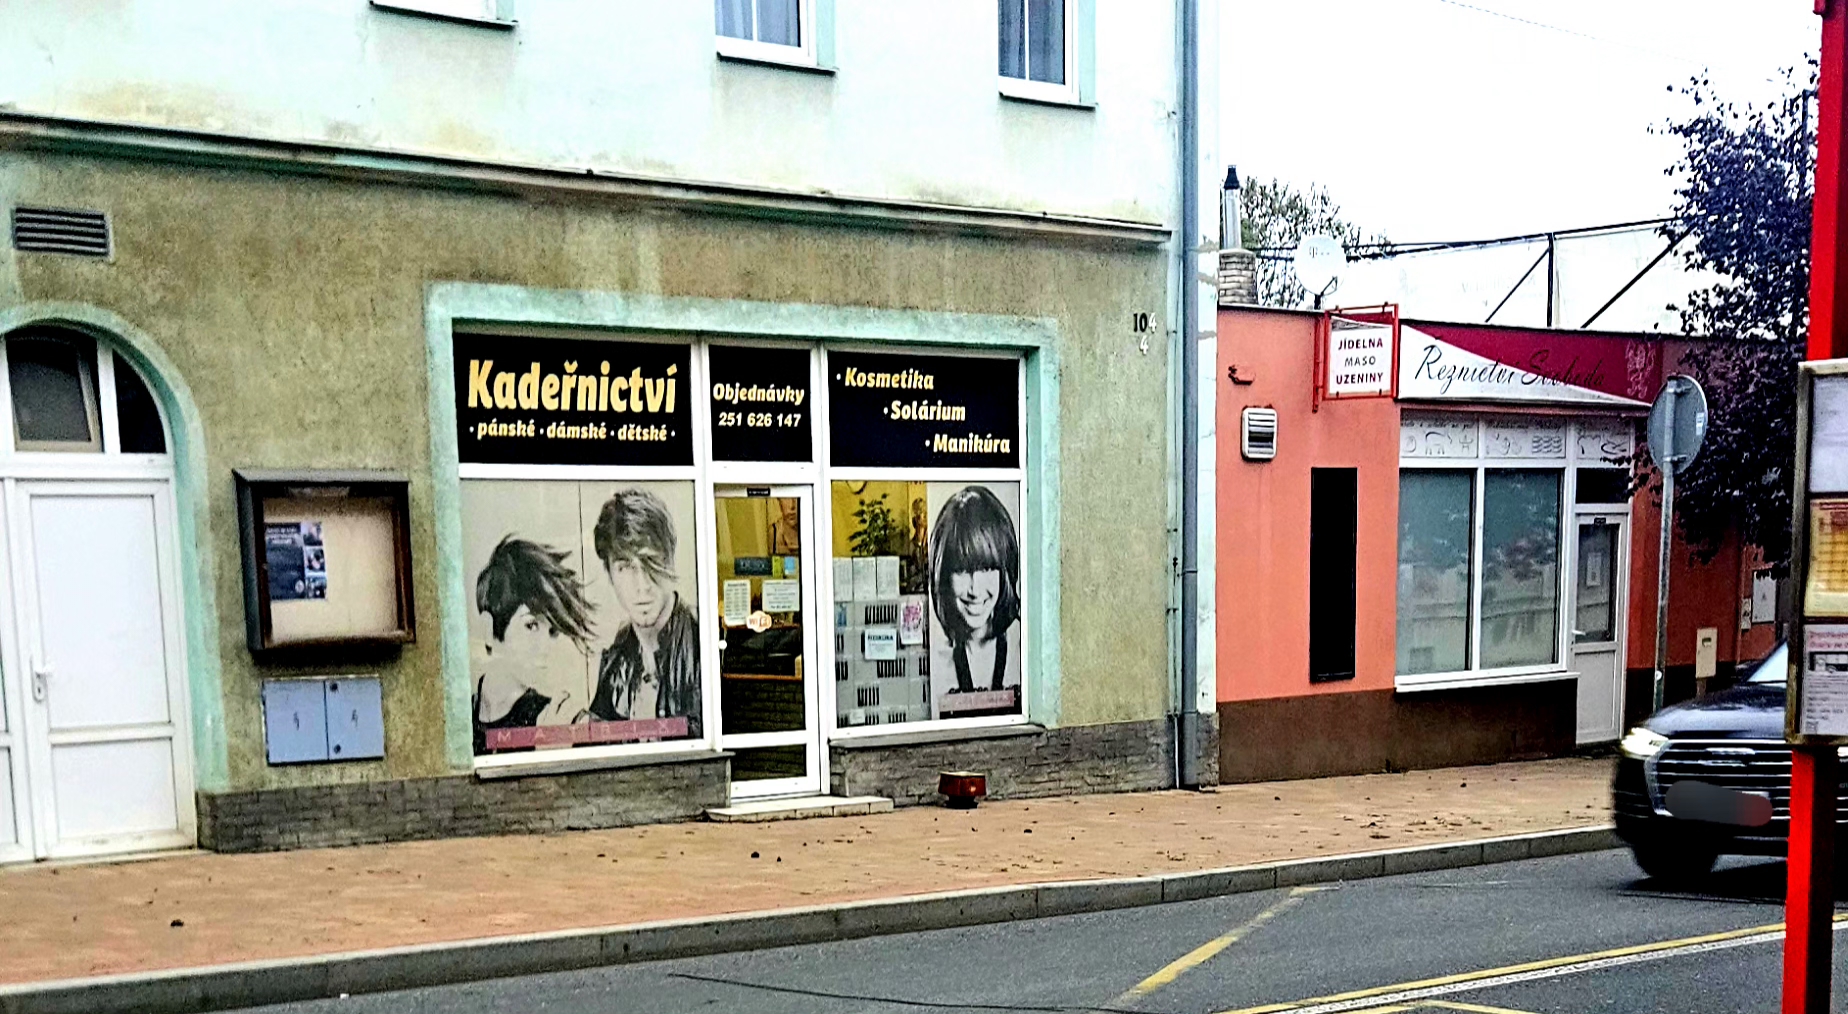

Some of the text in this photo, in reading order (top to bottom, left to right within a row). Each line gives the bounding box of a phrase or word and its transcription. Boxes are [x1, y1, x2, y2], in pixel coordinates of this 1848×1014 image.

[1133, 312, 1157, 334] 104
[1139, 335, 1149, 356] 4
[1338, 337, 1383, 350] JÍDELNA
[1344, 356, 1376, 367] MASO
[467, 359, 678, 413] Kadeřnictví
[845, 367, 934, 390] Kosmetika
[1336, 372, 1383, 385] UZENINY
[713, 382, 804, 406] Objednávky
[718, 411, 801, 428] 251 626 147
[890, 400, 966, 421] Solárium
[477, 418, 667, 441] pánské dámské dětské
[933, 433, 1011, 454] Manikúra
